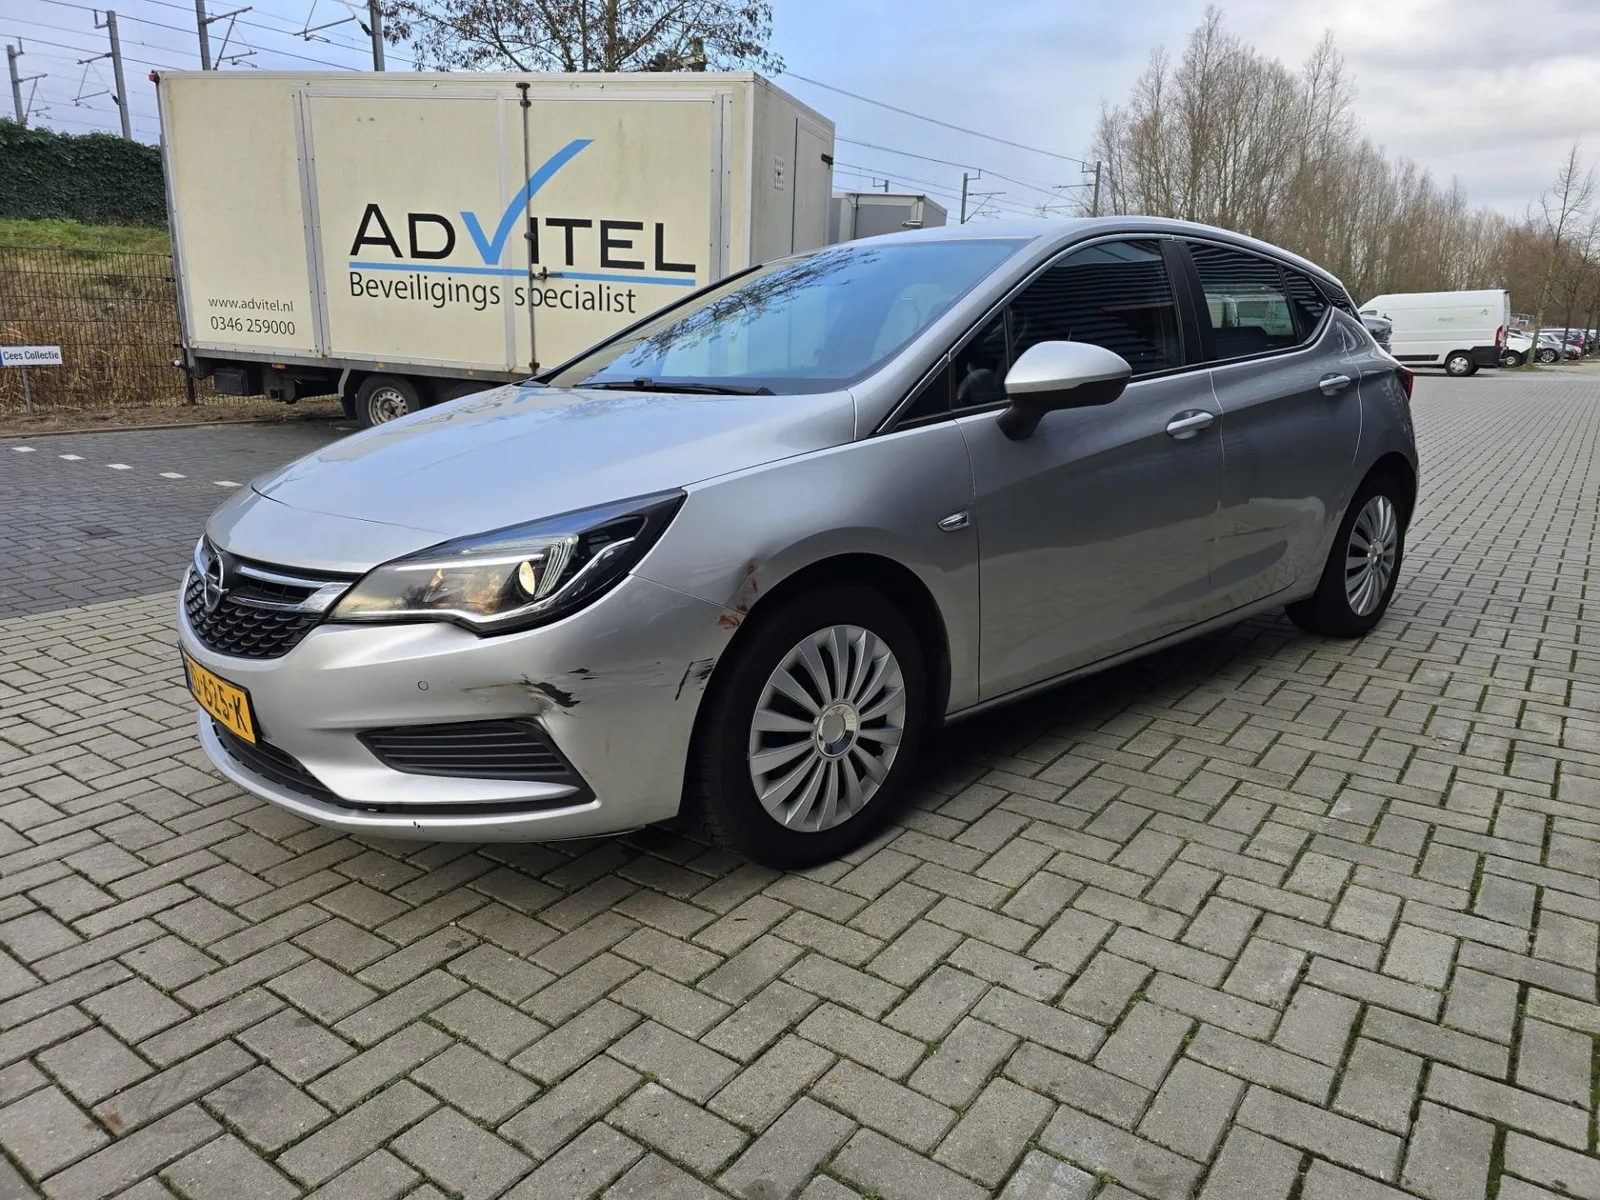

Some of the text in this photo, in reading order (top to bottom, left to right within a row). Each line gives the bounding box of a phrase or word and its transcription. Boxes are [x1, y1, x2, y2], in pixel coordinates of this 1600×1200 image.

[349, 139, 696, 274] ADVITEL
[349, 271, 636, 314] Beveiligings specialist
[208, 298, 294, 312] www.advitel.nl
[210, 316, 295, 335] 0346 259000
[3, 350, 60, 360] Cees Collectie
